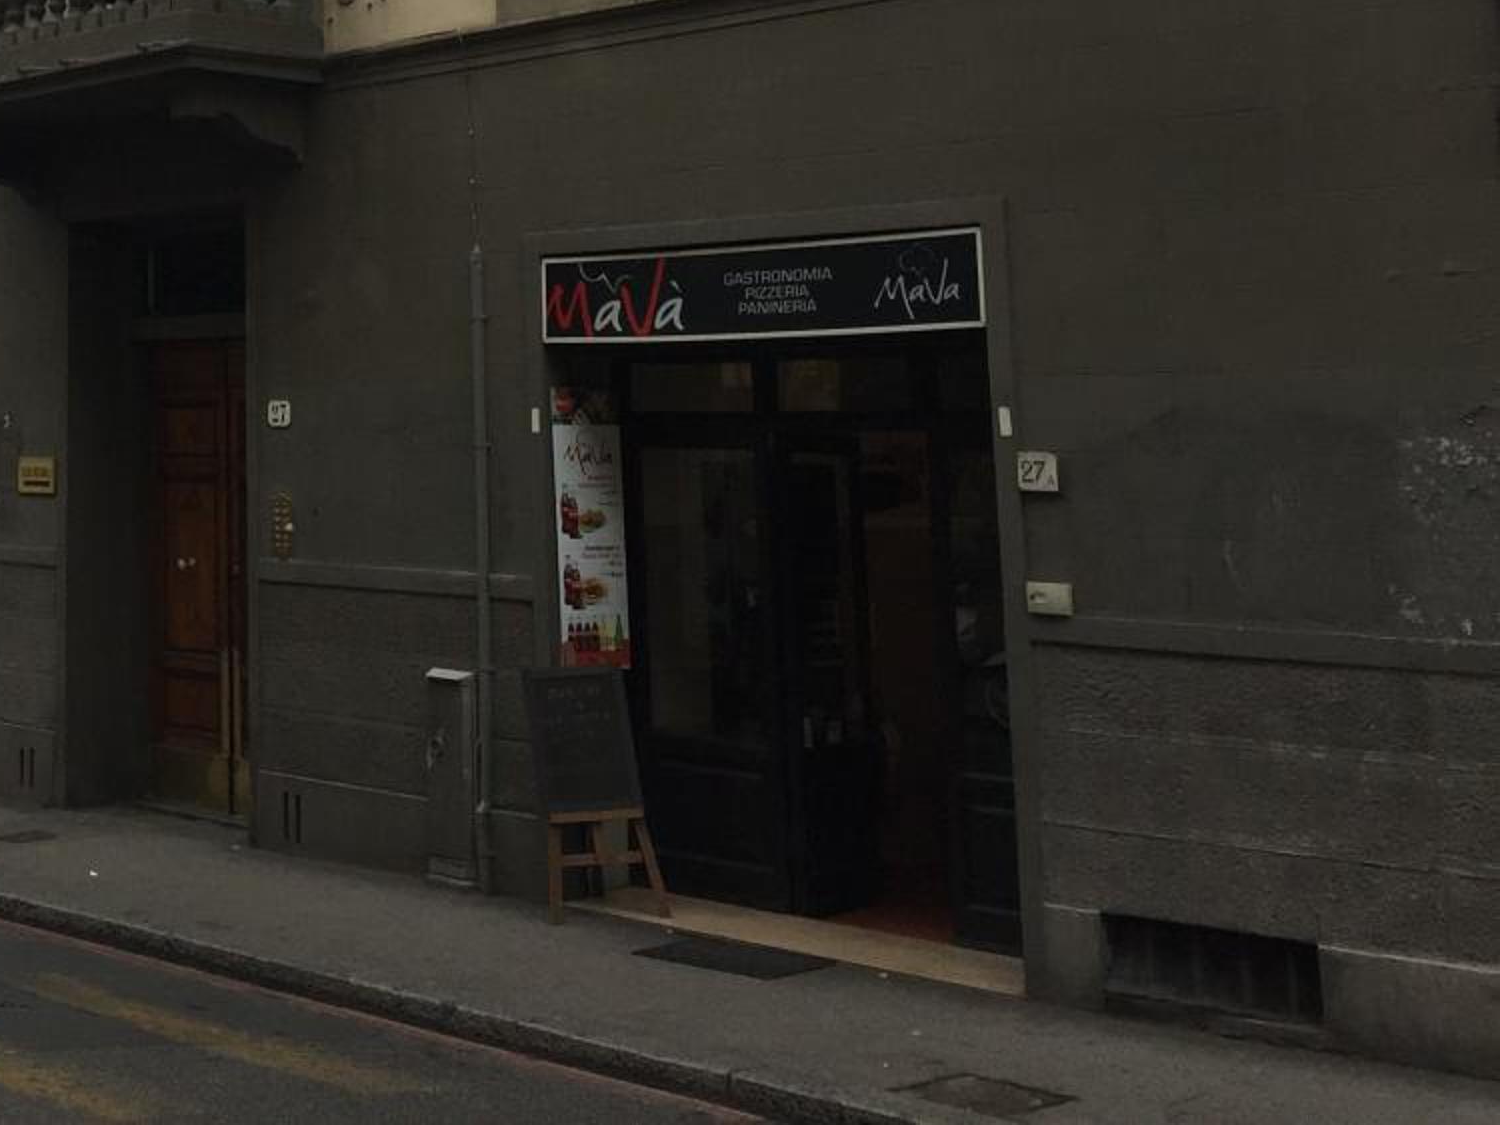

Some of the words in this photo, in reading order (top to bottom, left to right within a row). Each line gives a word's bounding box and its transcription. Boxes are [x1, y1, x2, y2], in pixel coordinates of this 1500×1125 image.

[723, 266, 833, 286] GASTRONOMIA
[744, 283, 810, 300] PIZZERIA
[738, 298, 818, 315] PANINERIA
[1020, 459, 1045, 484] 27
